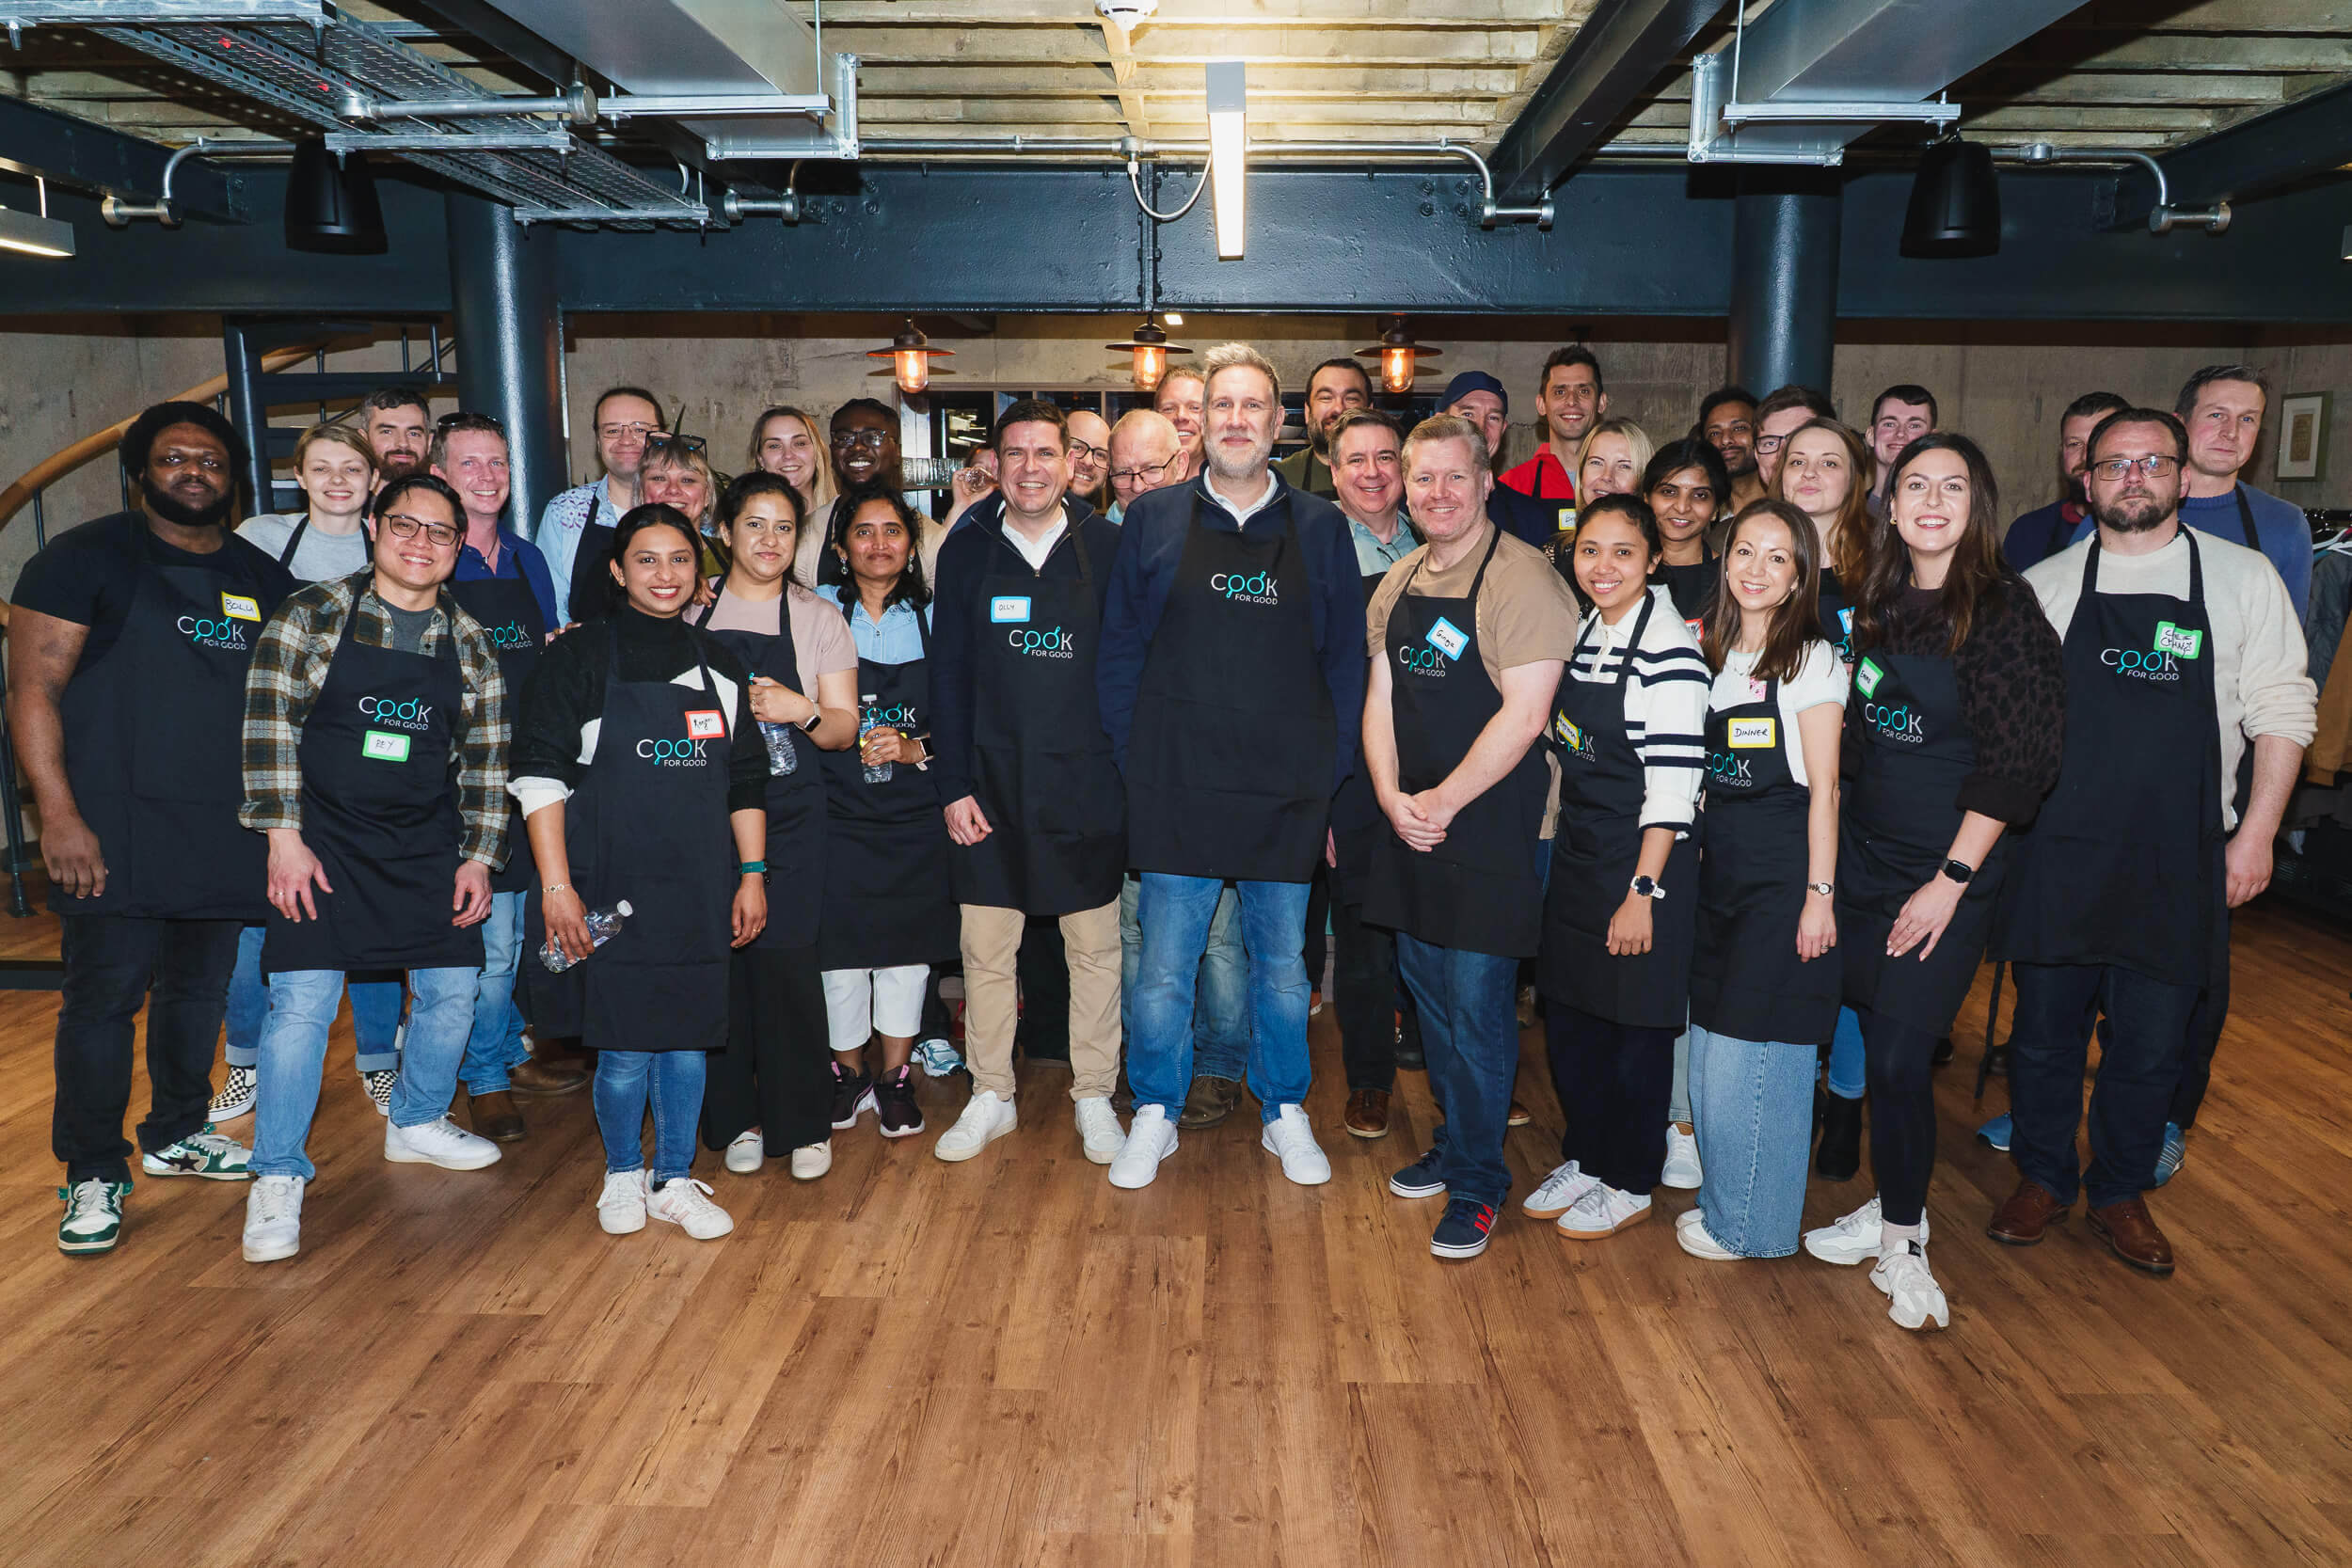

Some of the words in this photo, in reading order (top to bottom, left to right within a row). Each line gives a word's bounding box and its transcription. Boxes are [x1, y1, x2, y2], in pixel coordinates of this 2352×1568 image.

[1210, 570, 1278, 598] COOK
[1234, 594, 1251, 602] FOR
[1252, 595, 1279, 605] GOOD
[177, 616, 246, 641] COOK
[203, 639, 219, 647] FOR
[220, 641, 246, 650] GOOD
[1009, 626, 1073, 654] COOK
[1031, 649, 1047, 657] FOR
[1399, 644, 1446, 672] COOK
[2100, 648, 2179, 674] COOK
[1425, 669, 1446, 677] GOOD
[2127, 669, 2147, 678] FOR
[2149, 673, 2180, 681] GOOD
[358, 696, 433, 722] COOK
[858, 703, 916, 723] OOK
[384, 718, 401, 727] FOR
[403, 721, 429, 731] GOOD
[1865, 704, 1922, 735] COOK
[1733, 728, 1769, 737] DINNER
[1895, 733, 1923, 743] GOOD
[636, 737, 707, 766] COOK
[1716, 774, 1728, 783] FOR
[1729, 777, 1752, 787] GOOD
